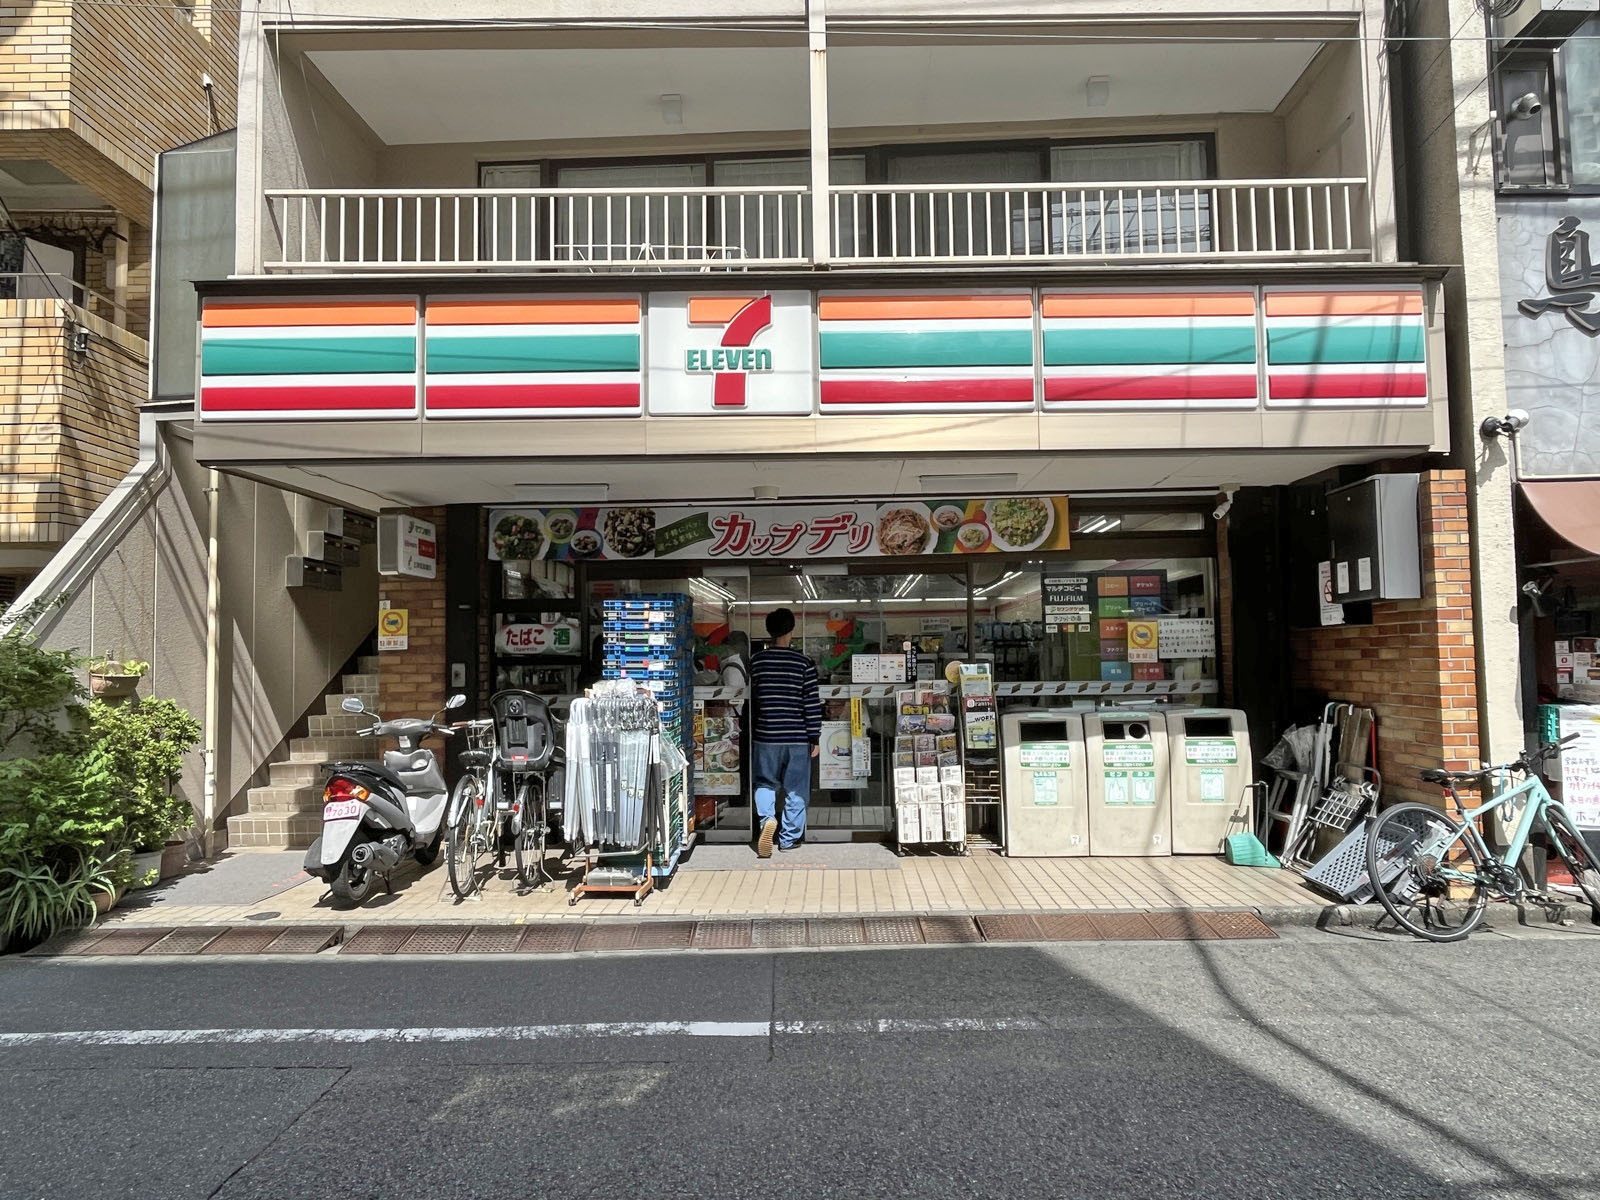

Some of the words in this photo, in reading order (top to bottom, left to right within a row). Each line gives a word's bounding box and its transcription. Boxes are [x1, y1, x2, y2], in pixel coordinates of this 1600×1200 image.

[709, 512, 873, 555] カップデリ
[506, 628, 545, 646] たばこ
[553, 628, 571, 645] 酒
[332, 805, 357, 817] 7030
